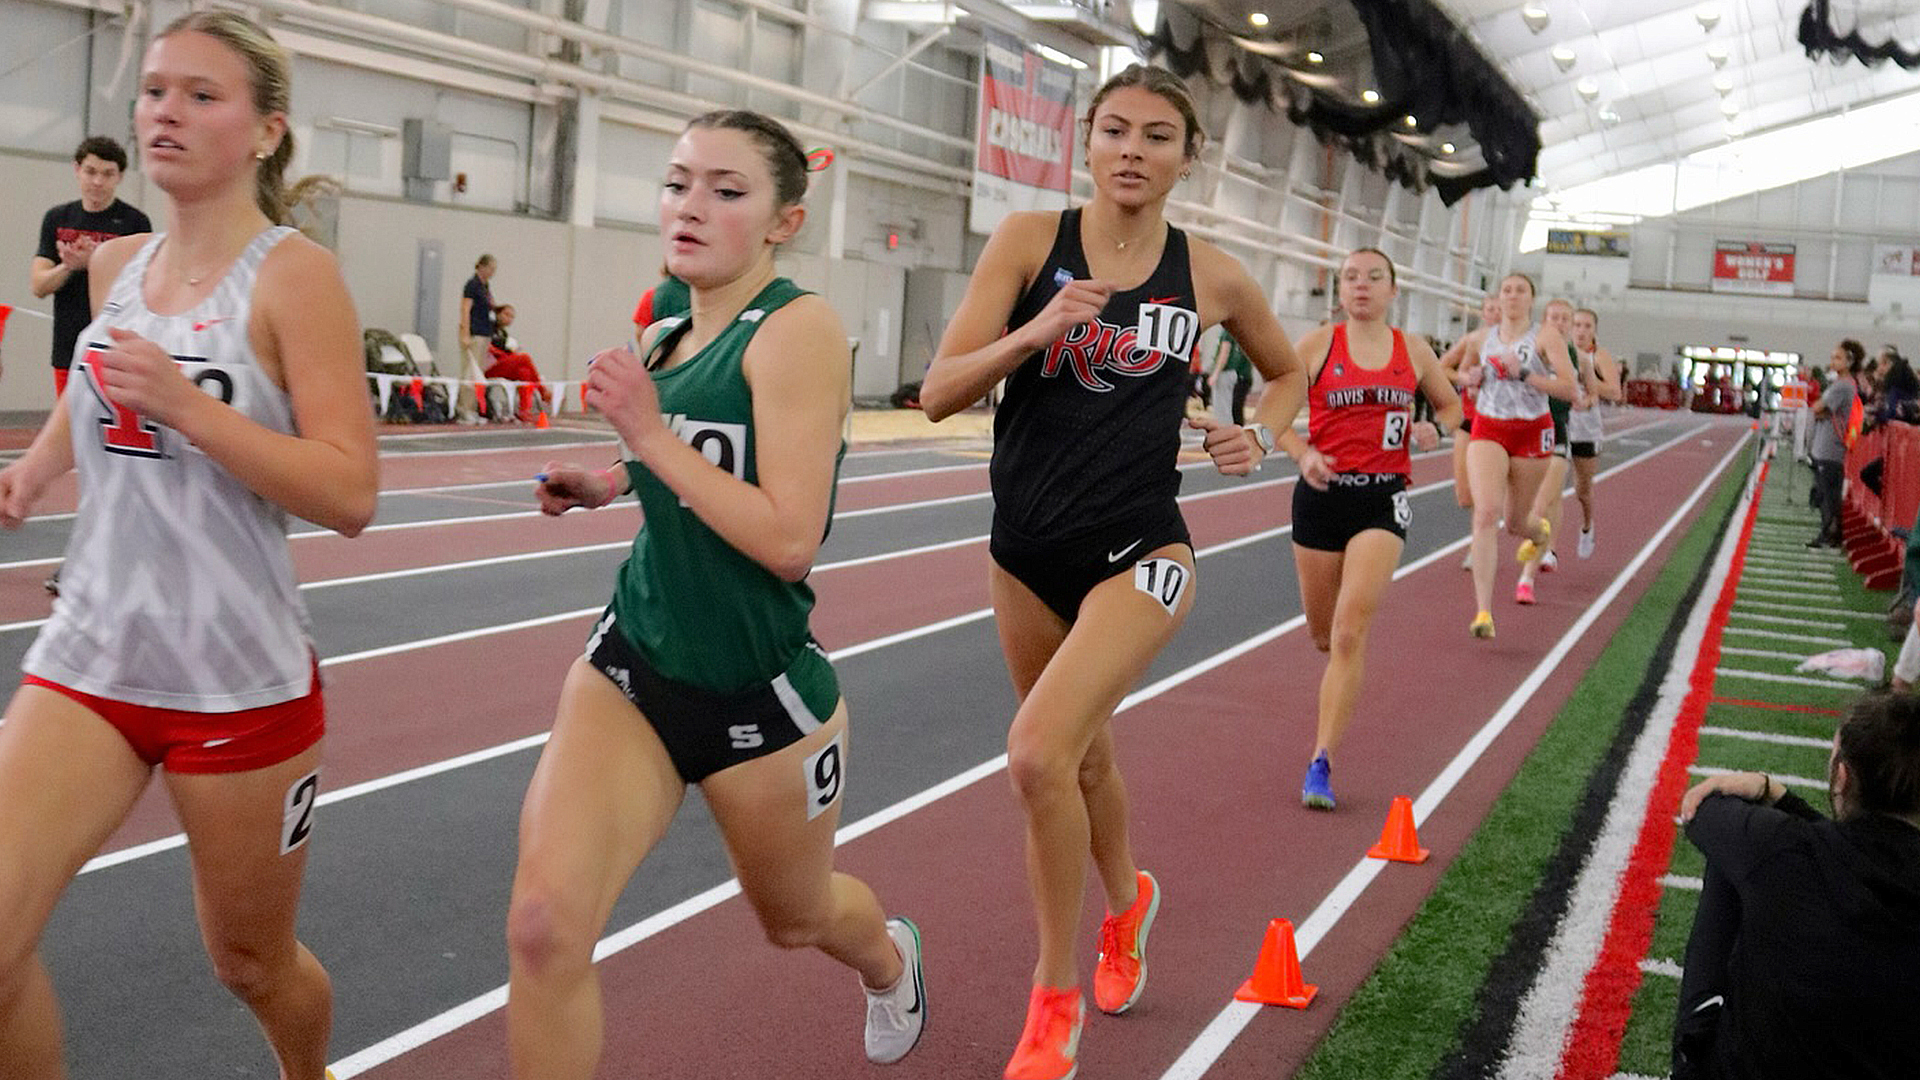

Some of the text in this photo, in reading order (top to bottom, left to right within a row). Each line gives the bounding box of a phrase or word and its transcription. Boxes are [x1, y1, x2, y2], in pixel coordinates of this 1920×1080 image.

[1144, 307, 1192, 355] 10
[1328, 388, 1364, 408] DAVIS
[1387, 416, 1404, 447] 3
[1141, 561, 1184, 607] 10
[727, 723, 764, 749] S
[815, 744, 841, 805] 9
[288, 774, 317, 848] 2
